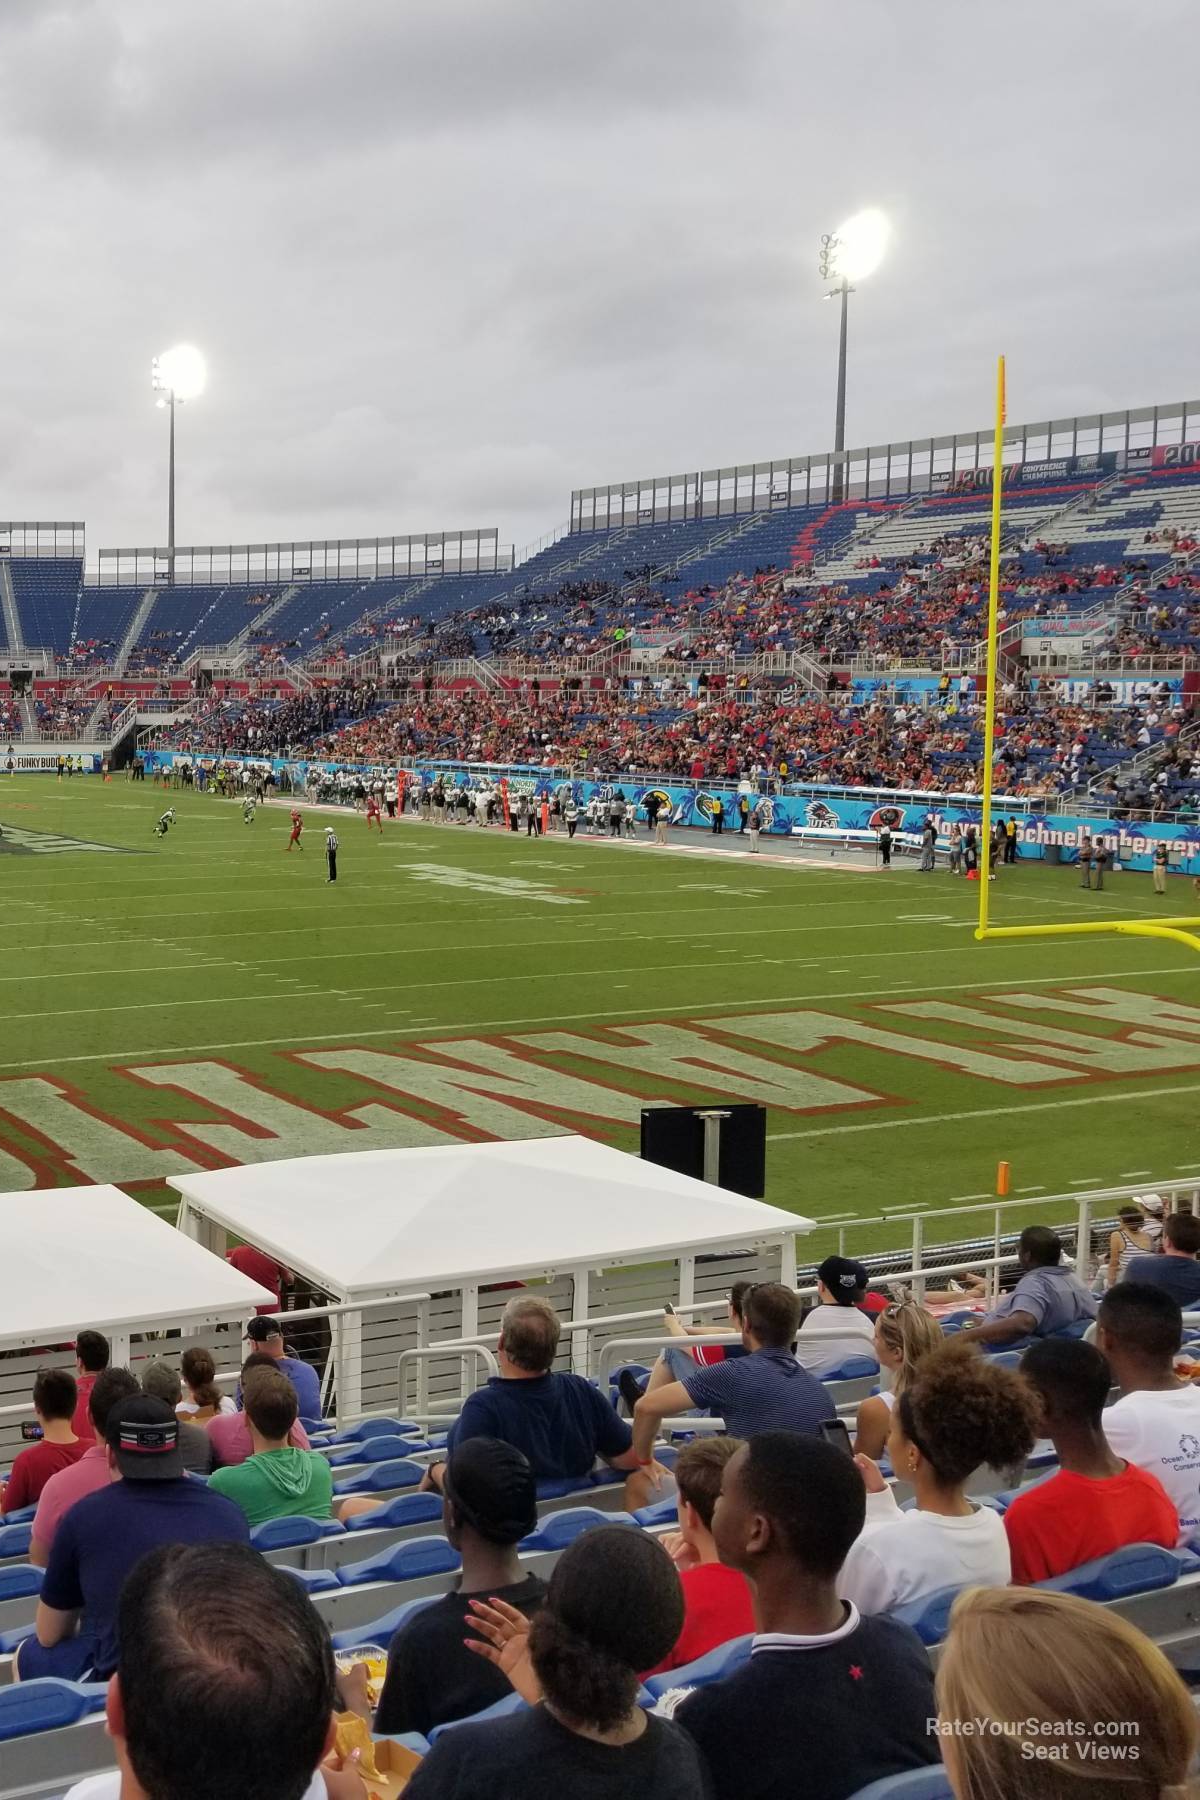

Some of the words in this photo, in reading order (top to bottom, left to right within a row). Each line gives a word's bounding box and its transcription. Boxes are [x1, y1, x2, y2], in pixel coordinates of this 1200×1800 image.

[1164, 443, 1200, 464] 20
[962, 465, 1013, 485] 207
[17, 757, 40, 769] FUNKY
[810, 819, 836, 828] UTSA
[1161, 1455, 1184, 1464] Ocean
